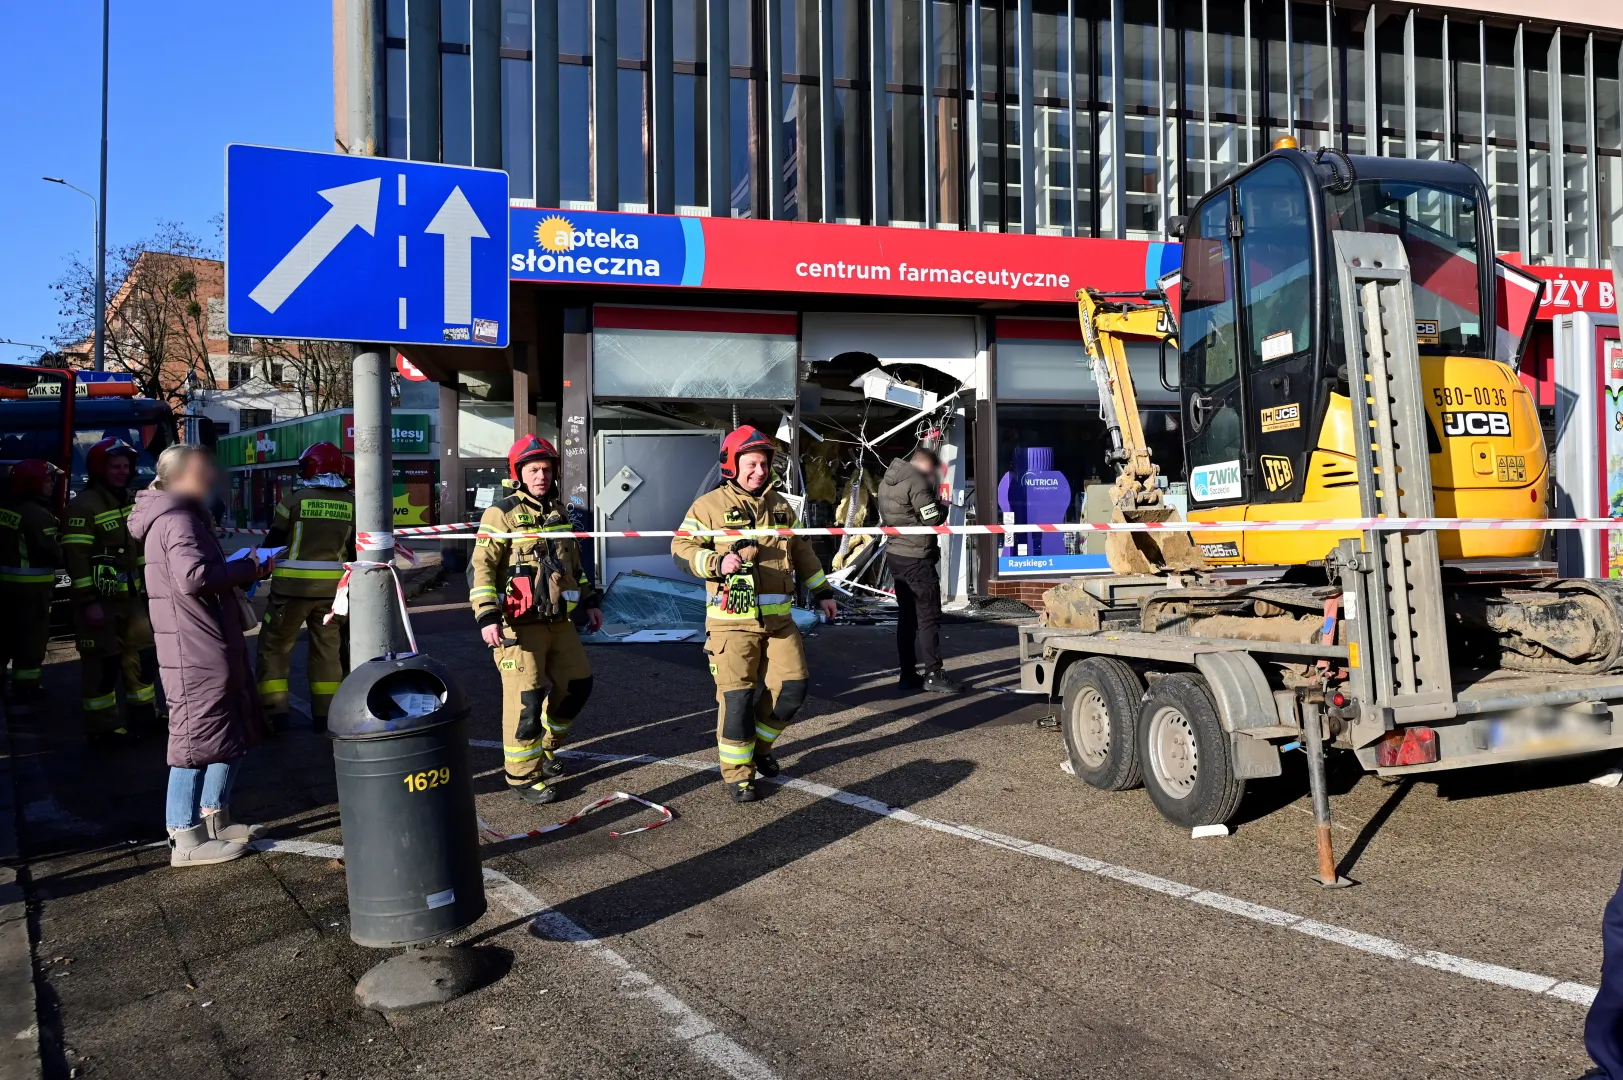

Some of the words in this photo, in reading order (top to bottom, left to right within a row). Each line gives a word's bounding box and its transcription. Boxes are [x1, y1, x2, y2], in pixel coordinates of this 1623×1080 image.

[554, 228, 639, 250] apteka
[511, 249, 660, 276] słoneczna
[795, 260, 891, 281] centrum
[899, 263, 1071, 289] farmaceutyczne
[1540, 273, 1589, 308] UŻY
[1415, 323, 1436, 334] CB
[50, 386, 86, 395] SZCIN
[1433, 387, 1507, 407] 580-0036
[1262, 411, 1273, 423] IH
[1275, 407, 1298, 421] JCB
[1446, 412, 1510, 435] JCB
[1024, 478, 1059, 486] NUTRICIA
[1209, 467, 1239, 486] ZWiK
[1265, 460, 1291, 491] JCB
[1008, 559, 1047, 568] Rayskiego
[502, 661, 514, 669] PSP
[403, 767, 450, 793] 1629
